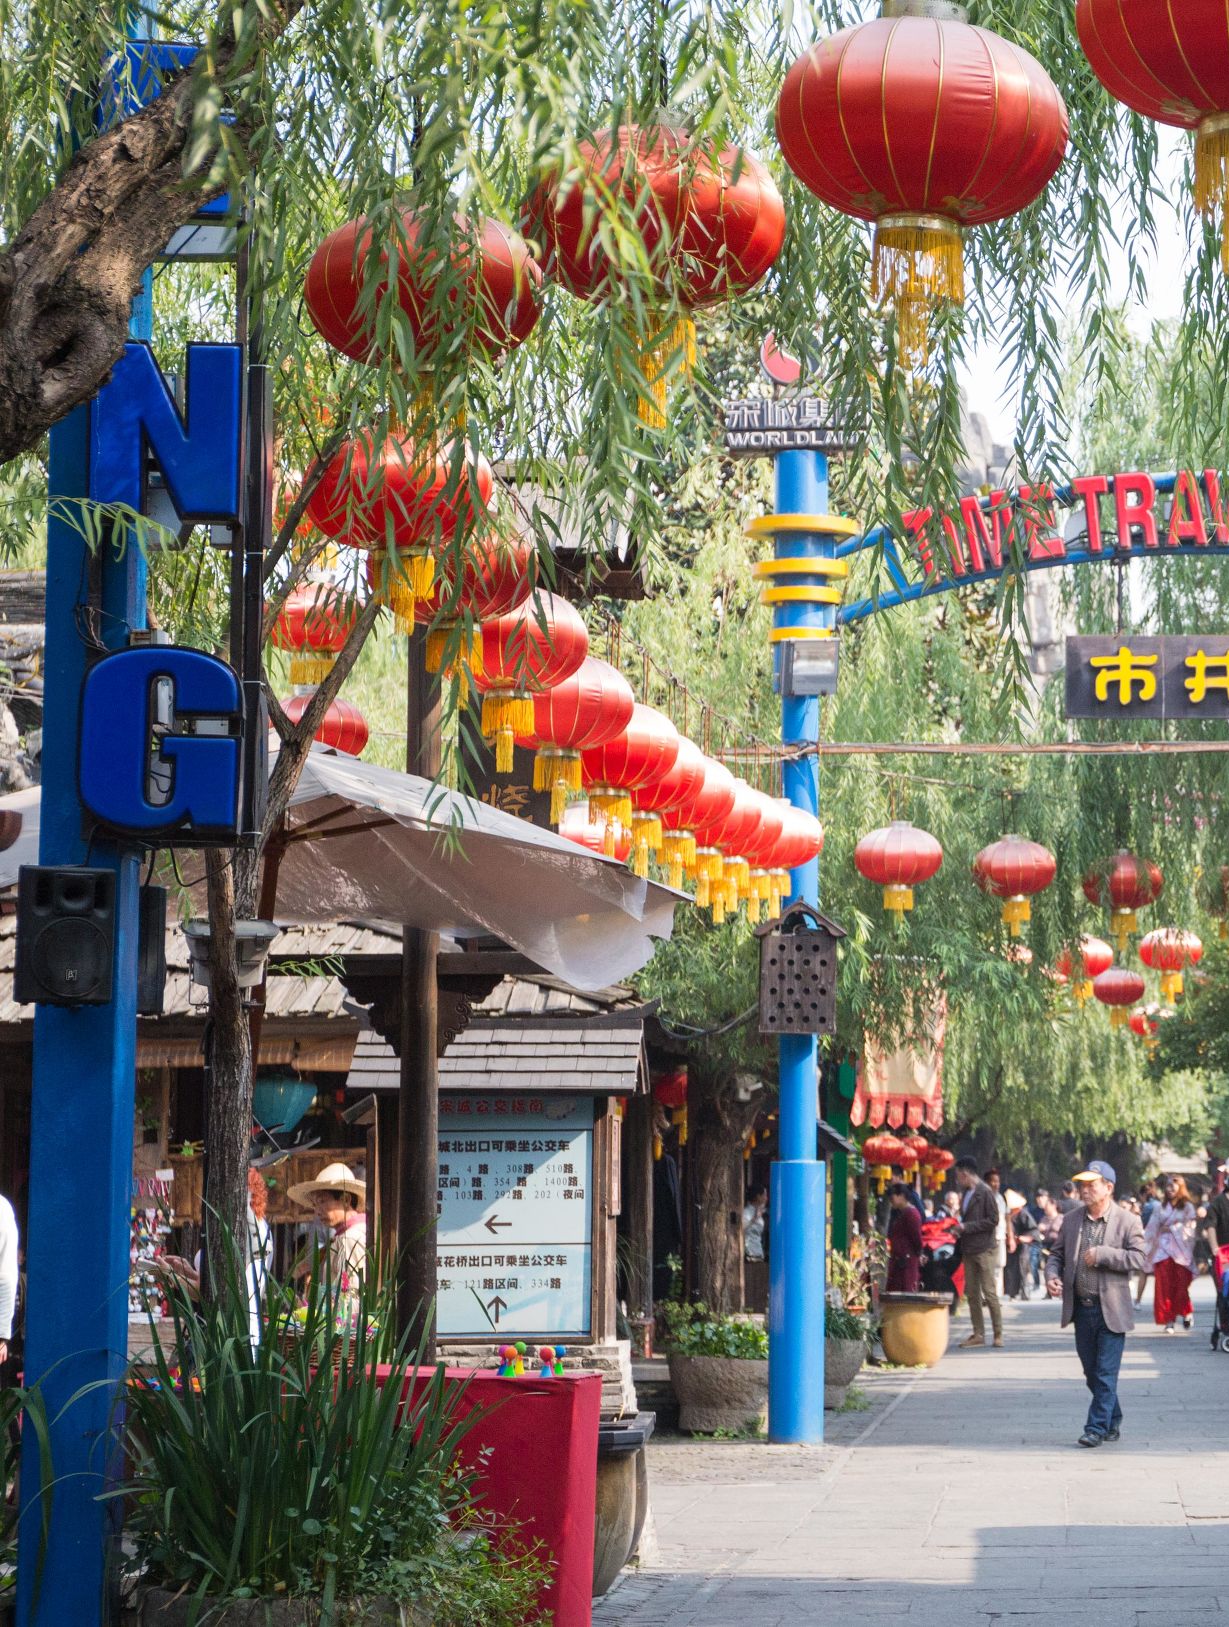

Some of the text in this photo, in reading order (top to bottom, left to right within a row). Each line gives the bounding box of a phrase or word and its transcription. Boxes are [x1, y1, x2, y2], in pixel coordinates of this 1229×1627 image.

[727, 398, 870, 428] 宋城集
[901, 482, 1066, 585] TIME
